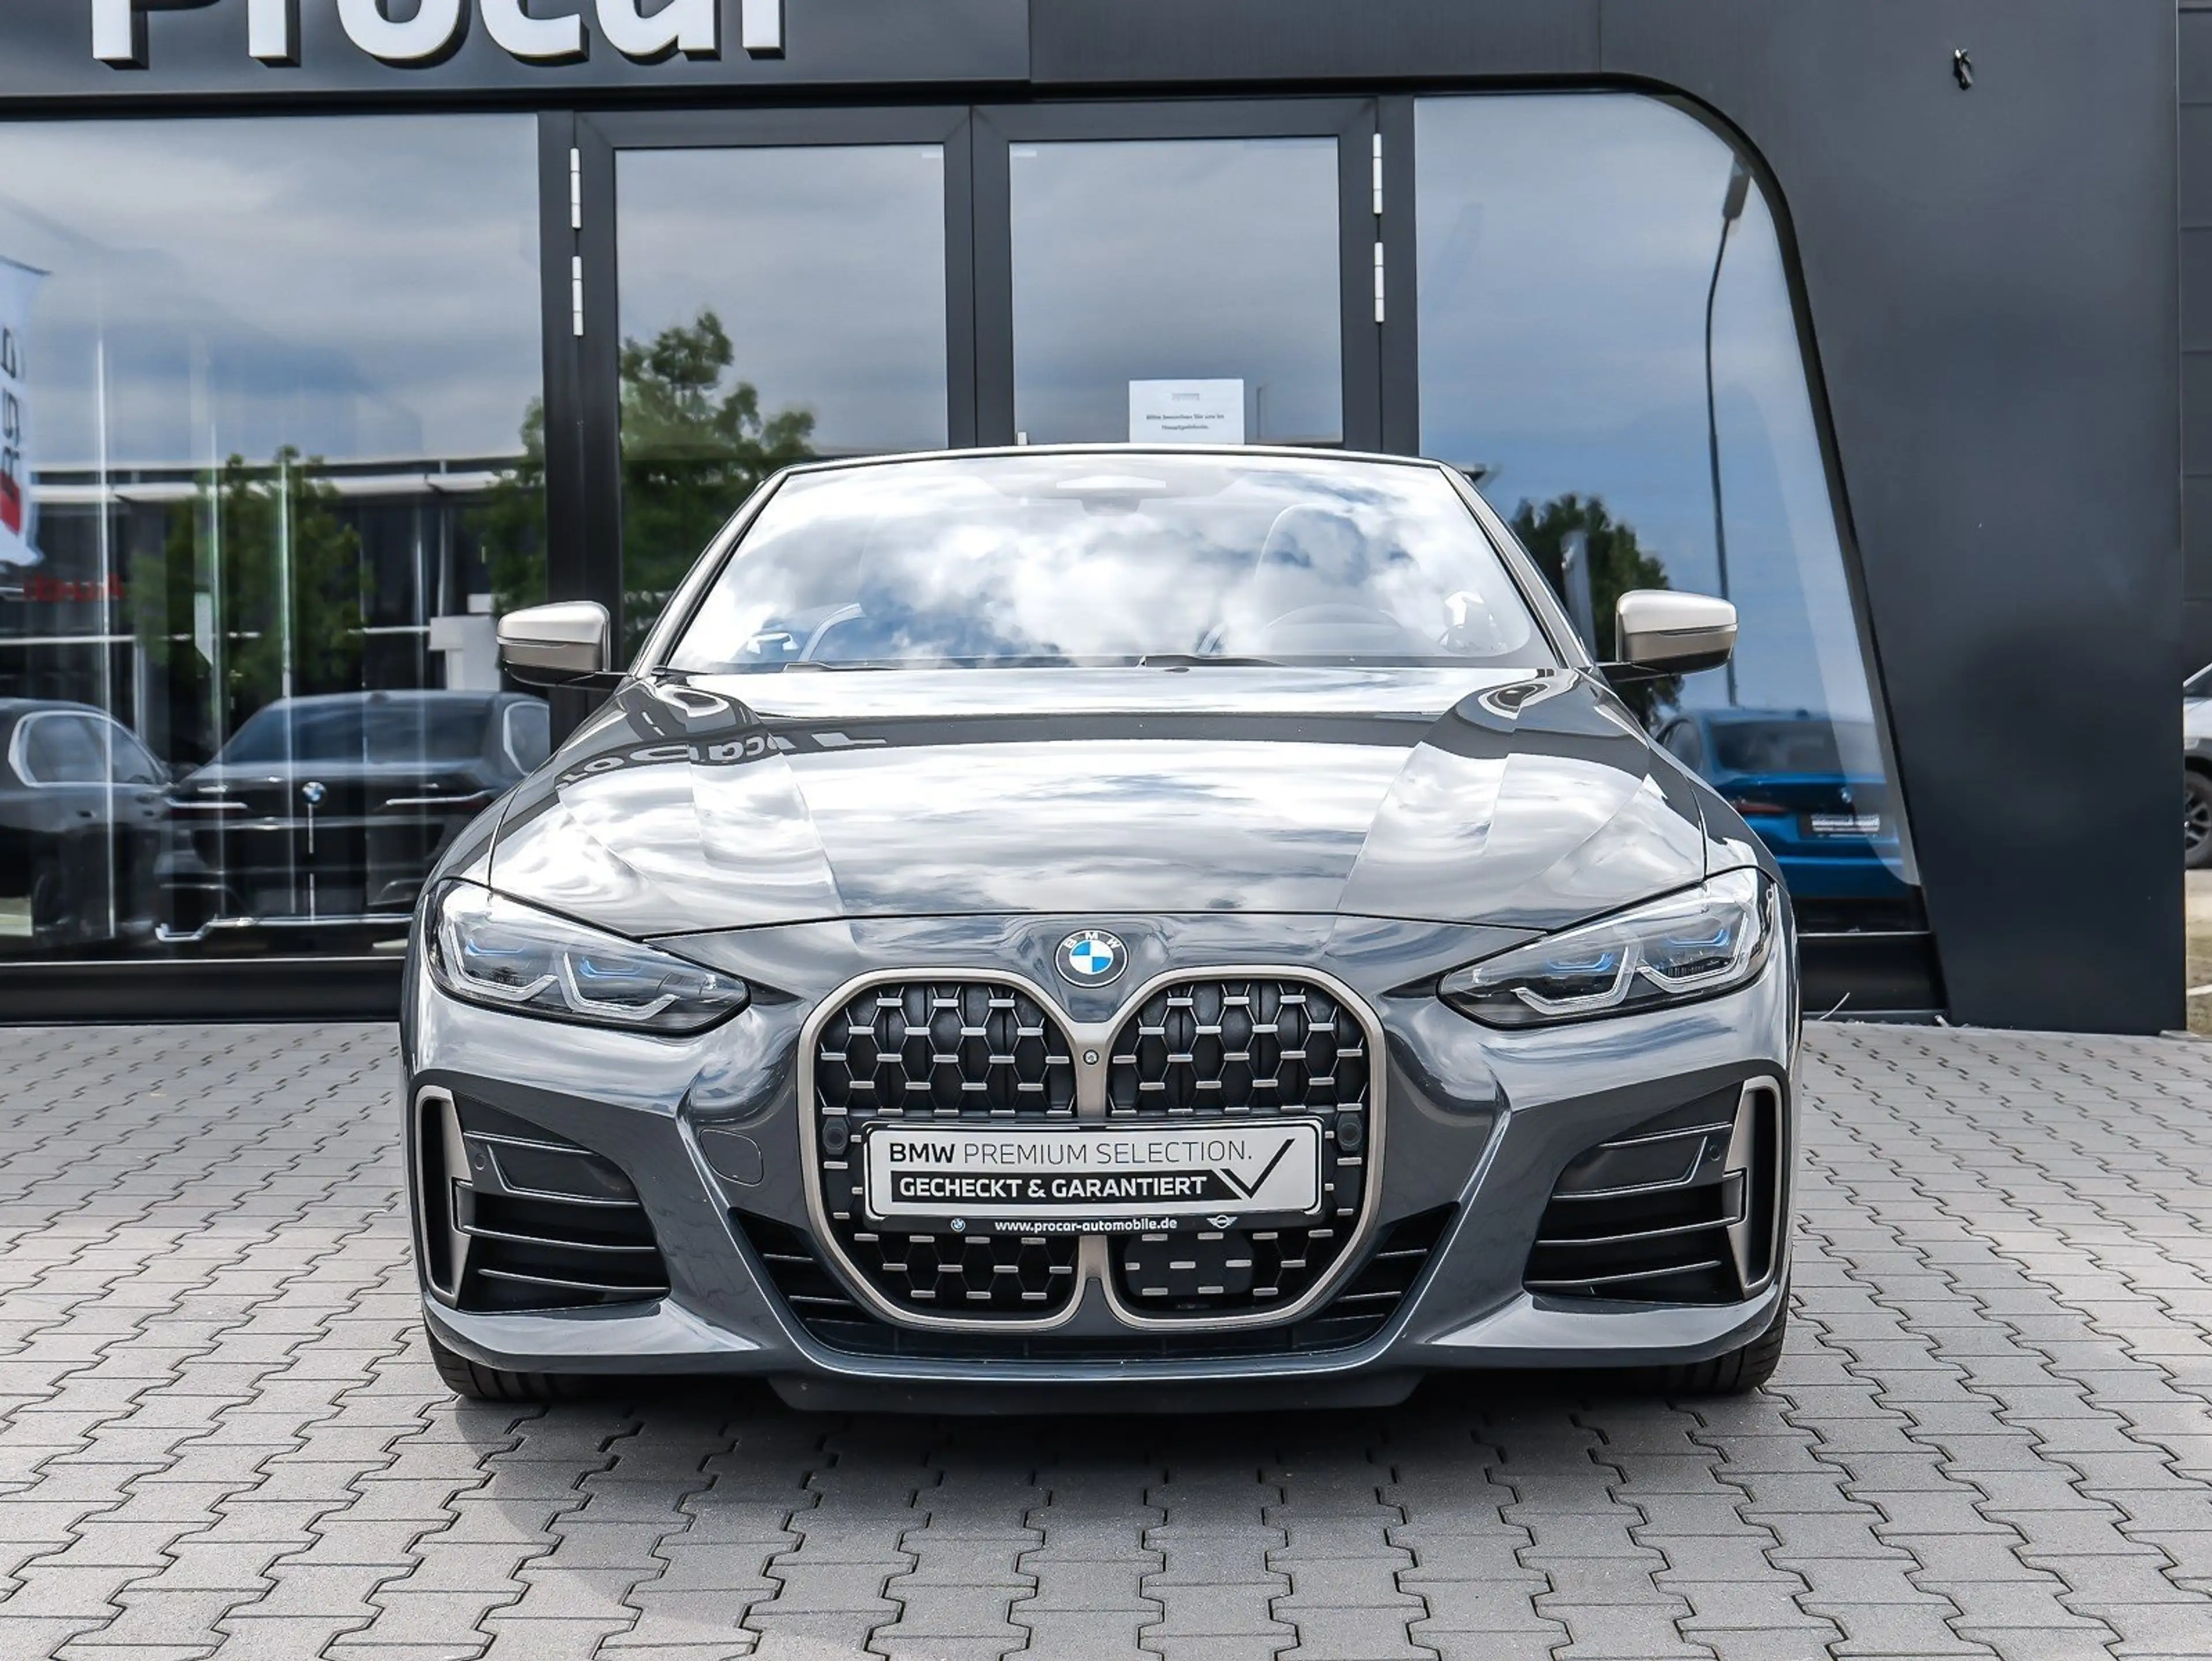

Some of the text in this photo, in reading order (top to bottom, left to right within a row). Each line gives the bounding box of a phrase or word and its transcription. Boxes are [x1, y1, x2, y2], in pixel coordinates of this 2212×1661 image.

[1063, 931, 1121, 949] BMW
[889, 1140, 1252, 1164] BMW PREMIUM SELECTION.
[899, 1176, 1207, 1198] GECHECKT & GARANTIERT
[994, 1217, 1178, 1234] www.procar-automobile.de
